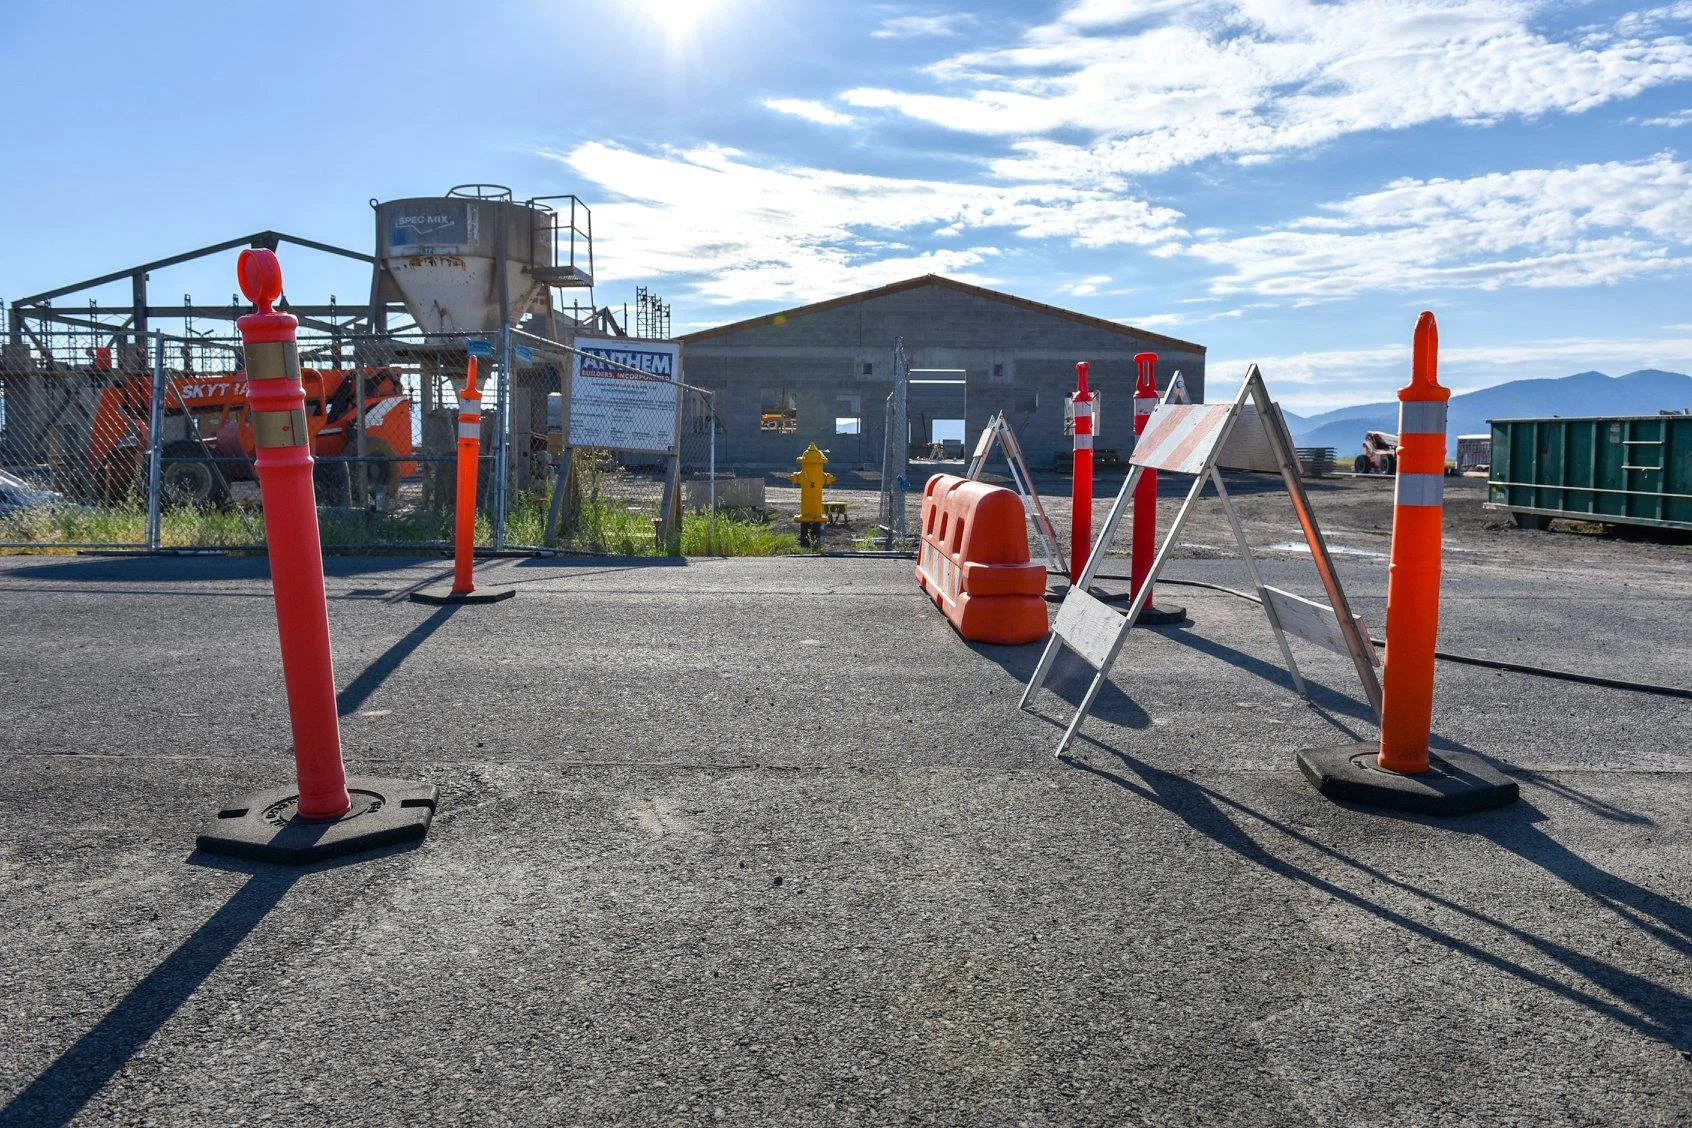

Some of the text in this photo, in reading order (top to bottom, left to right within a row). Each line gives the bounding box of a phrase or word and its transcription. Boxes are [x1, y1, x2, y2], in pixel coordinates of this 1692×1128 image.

[399, 215, 449, 225] SPEC MIX
[581, 347, 671, 374] ANTHEM
